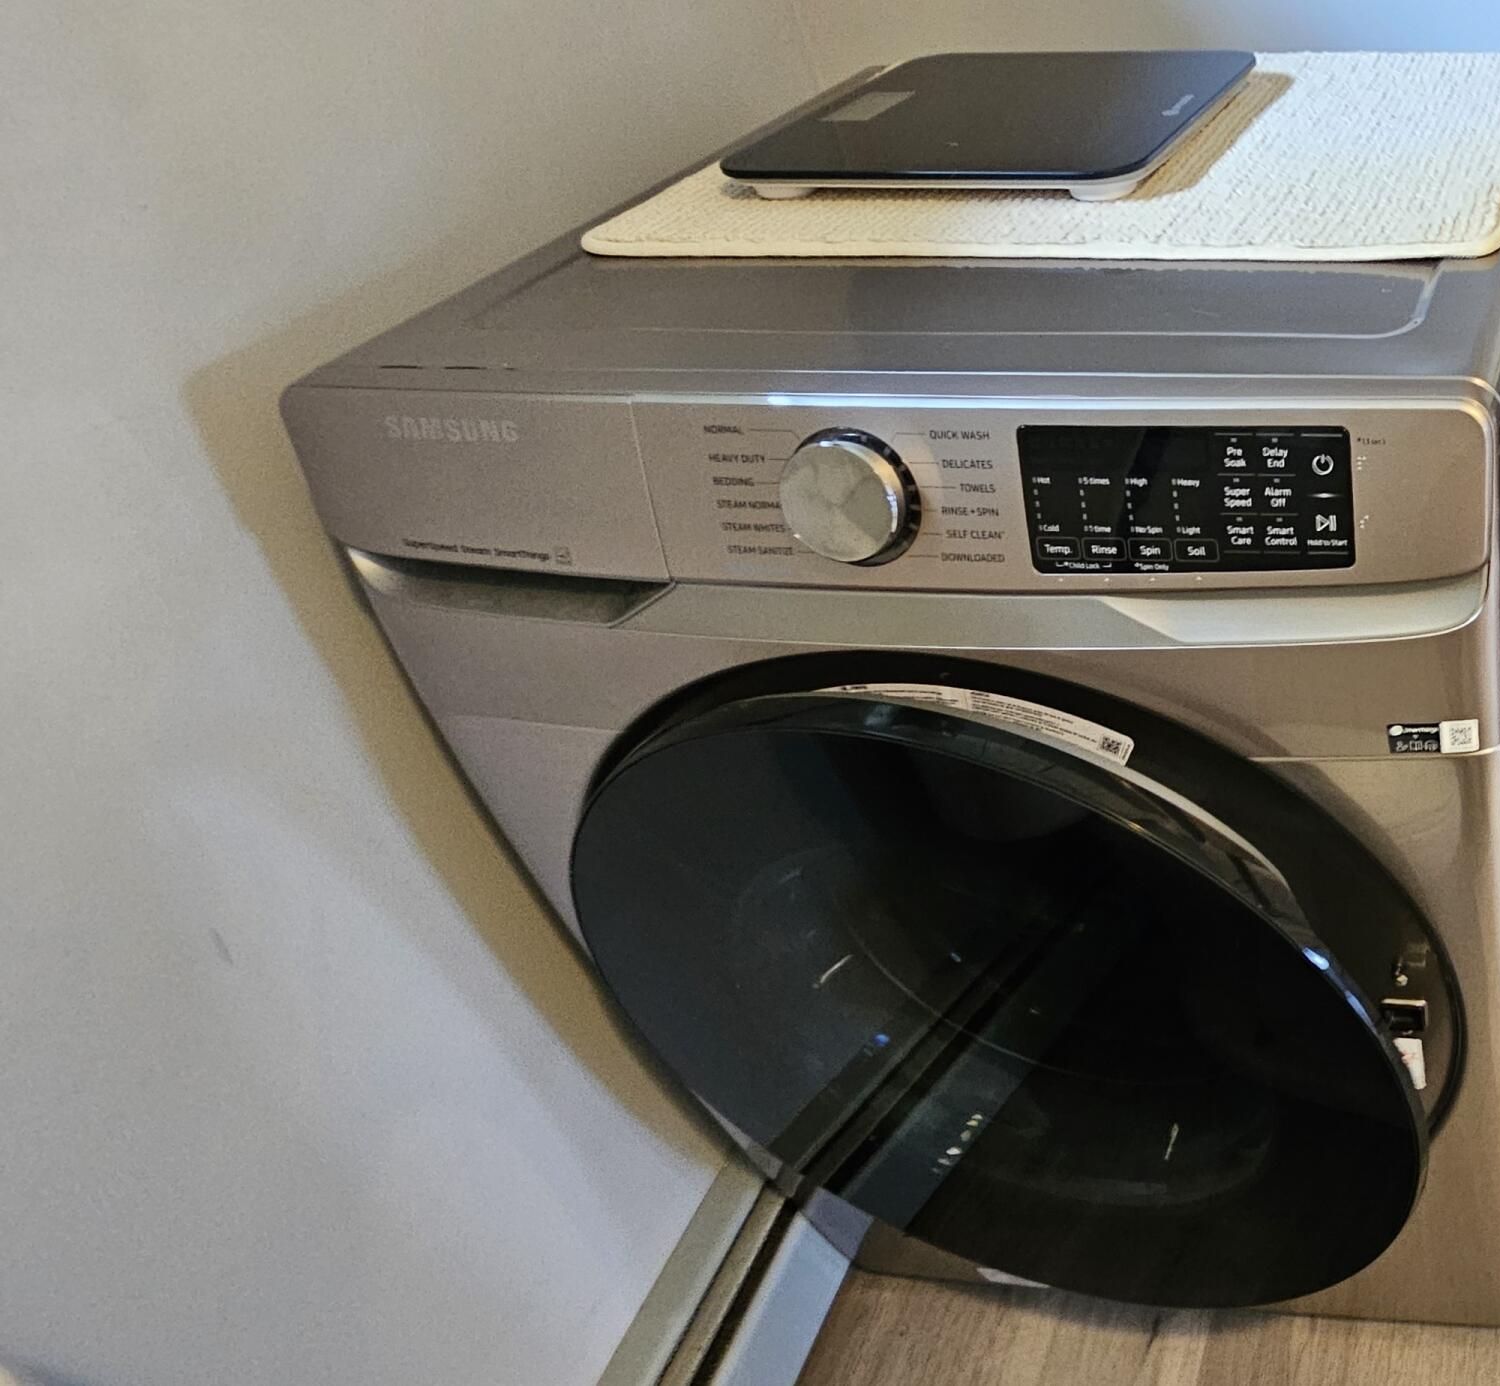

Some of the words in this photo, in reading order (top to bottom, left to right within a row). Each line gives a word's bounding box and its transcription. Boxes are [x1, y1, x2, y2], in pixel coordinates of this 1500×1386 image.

[386, 416, 519, 442] SAMSUNG
[703, 424, 743, 435] NORMAL
[929, 430, 958, 440] QUICK
[961, 431, 990, 440] WASH
[1226, 446, 1243, 456] Pre
[1262, 446, 1288, 458] Delay
[708, 453, 739, 463] HEAVY
[741, 454, 765, 463] DUTY
[1224, 458, 1246, 468] Soak
[1267, 458, 1285, 468] End
[942, 459, 993, 469] DELICATES
[713, 476, 755, 486] BEDDING
[1037, 477, 1050, 485] Hot
[1130, 477, 1148, 488] High
[1177, 478, 1200, 488] Heavy
[960, 483, 996, 493] TOWELS
[1224, 486, 1250, 497] Super
[1264, 486, 1292, 496] Alarm
[717, 500, 746, 509] STEAM
[748, 501, 782, 509] NORMA
[1224, 498, 1252, 508] Speed
[1270, 498, 1286, 508] Off
[941, 506, 968, 516] RINSE
[977, 507, 999, 516] SPIN
[722, 522, 751, 531] STEAM
[753, 523, 785, 532] WHITES
[1043, 524, 1060, 533] Cold
[1182, 526, 1201, 536] Light
[1226, 525, 1254, 536] Smart
[1266, 525, 1294, 536] Smart
[945, 529, 968, 539] SELF
[1231, 535, 1252, 545] Care
[1264, 535, 1298, 546] Control
[727, 545, 757, 554] STEAM
[1044, 544, 1072, 555] Temp.
[1091, 544, 1118, 555] Rinse
[1139, 545, 1161, 556] Spin
[1187, 546, 1206, 557] Soil
[941, 551, 1005, 563] DOWNLOADED
